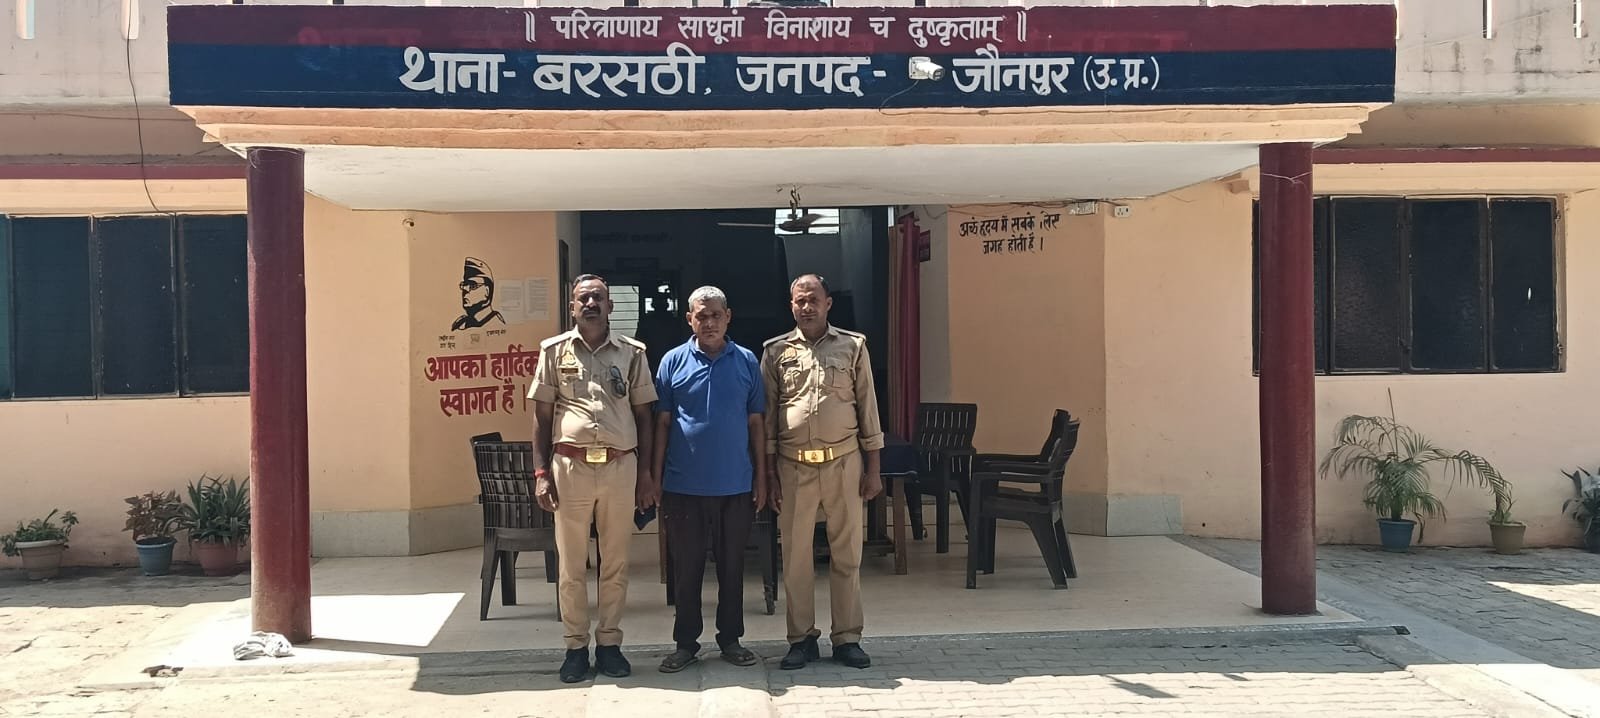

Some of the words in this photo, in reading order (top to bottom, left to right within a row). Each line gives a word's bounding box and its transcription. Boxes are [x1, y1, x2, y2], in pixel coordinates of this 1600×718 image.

[551, 9, 662, 41] परित्राणाय
[678, 10, 745, 44] साधूनां
[764, 12, 852, 42] विनाशाय
[869, 16, 896, 39] च
[909, 16, 1006, 48] दुष्कृताम्
[952, 44, 1075, 96] जौनपुर
[979, 219, 1000, 237] हृदय
[1001, 215, 1009, 233] में
[1011, 212, 1036, 234] सबके
[982, 238, 1005, 255] जगह
[1007, 234, 1028, 254] होती
[1028, 231, 1035, 253] है
[424, 353, 488, 382] आपका
[440, 385, 500, 417] स्वागत
